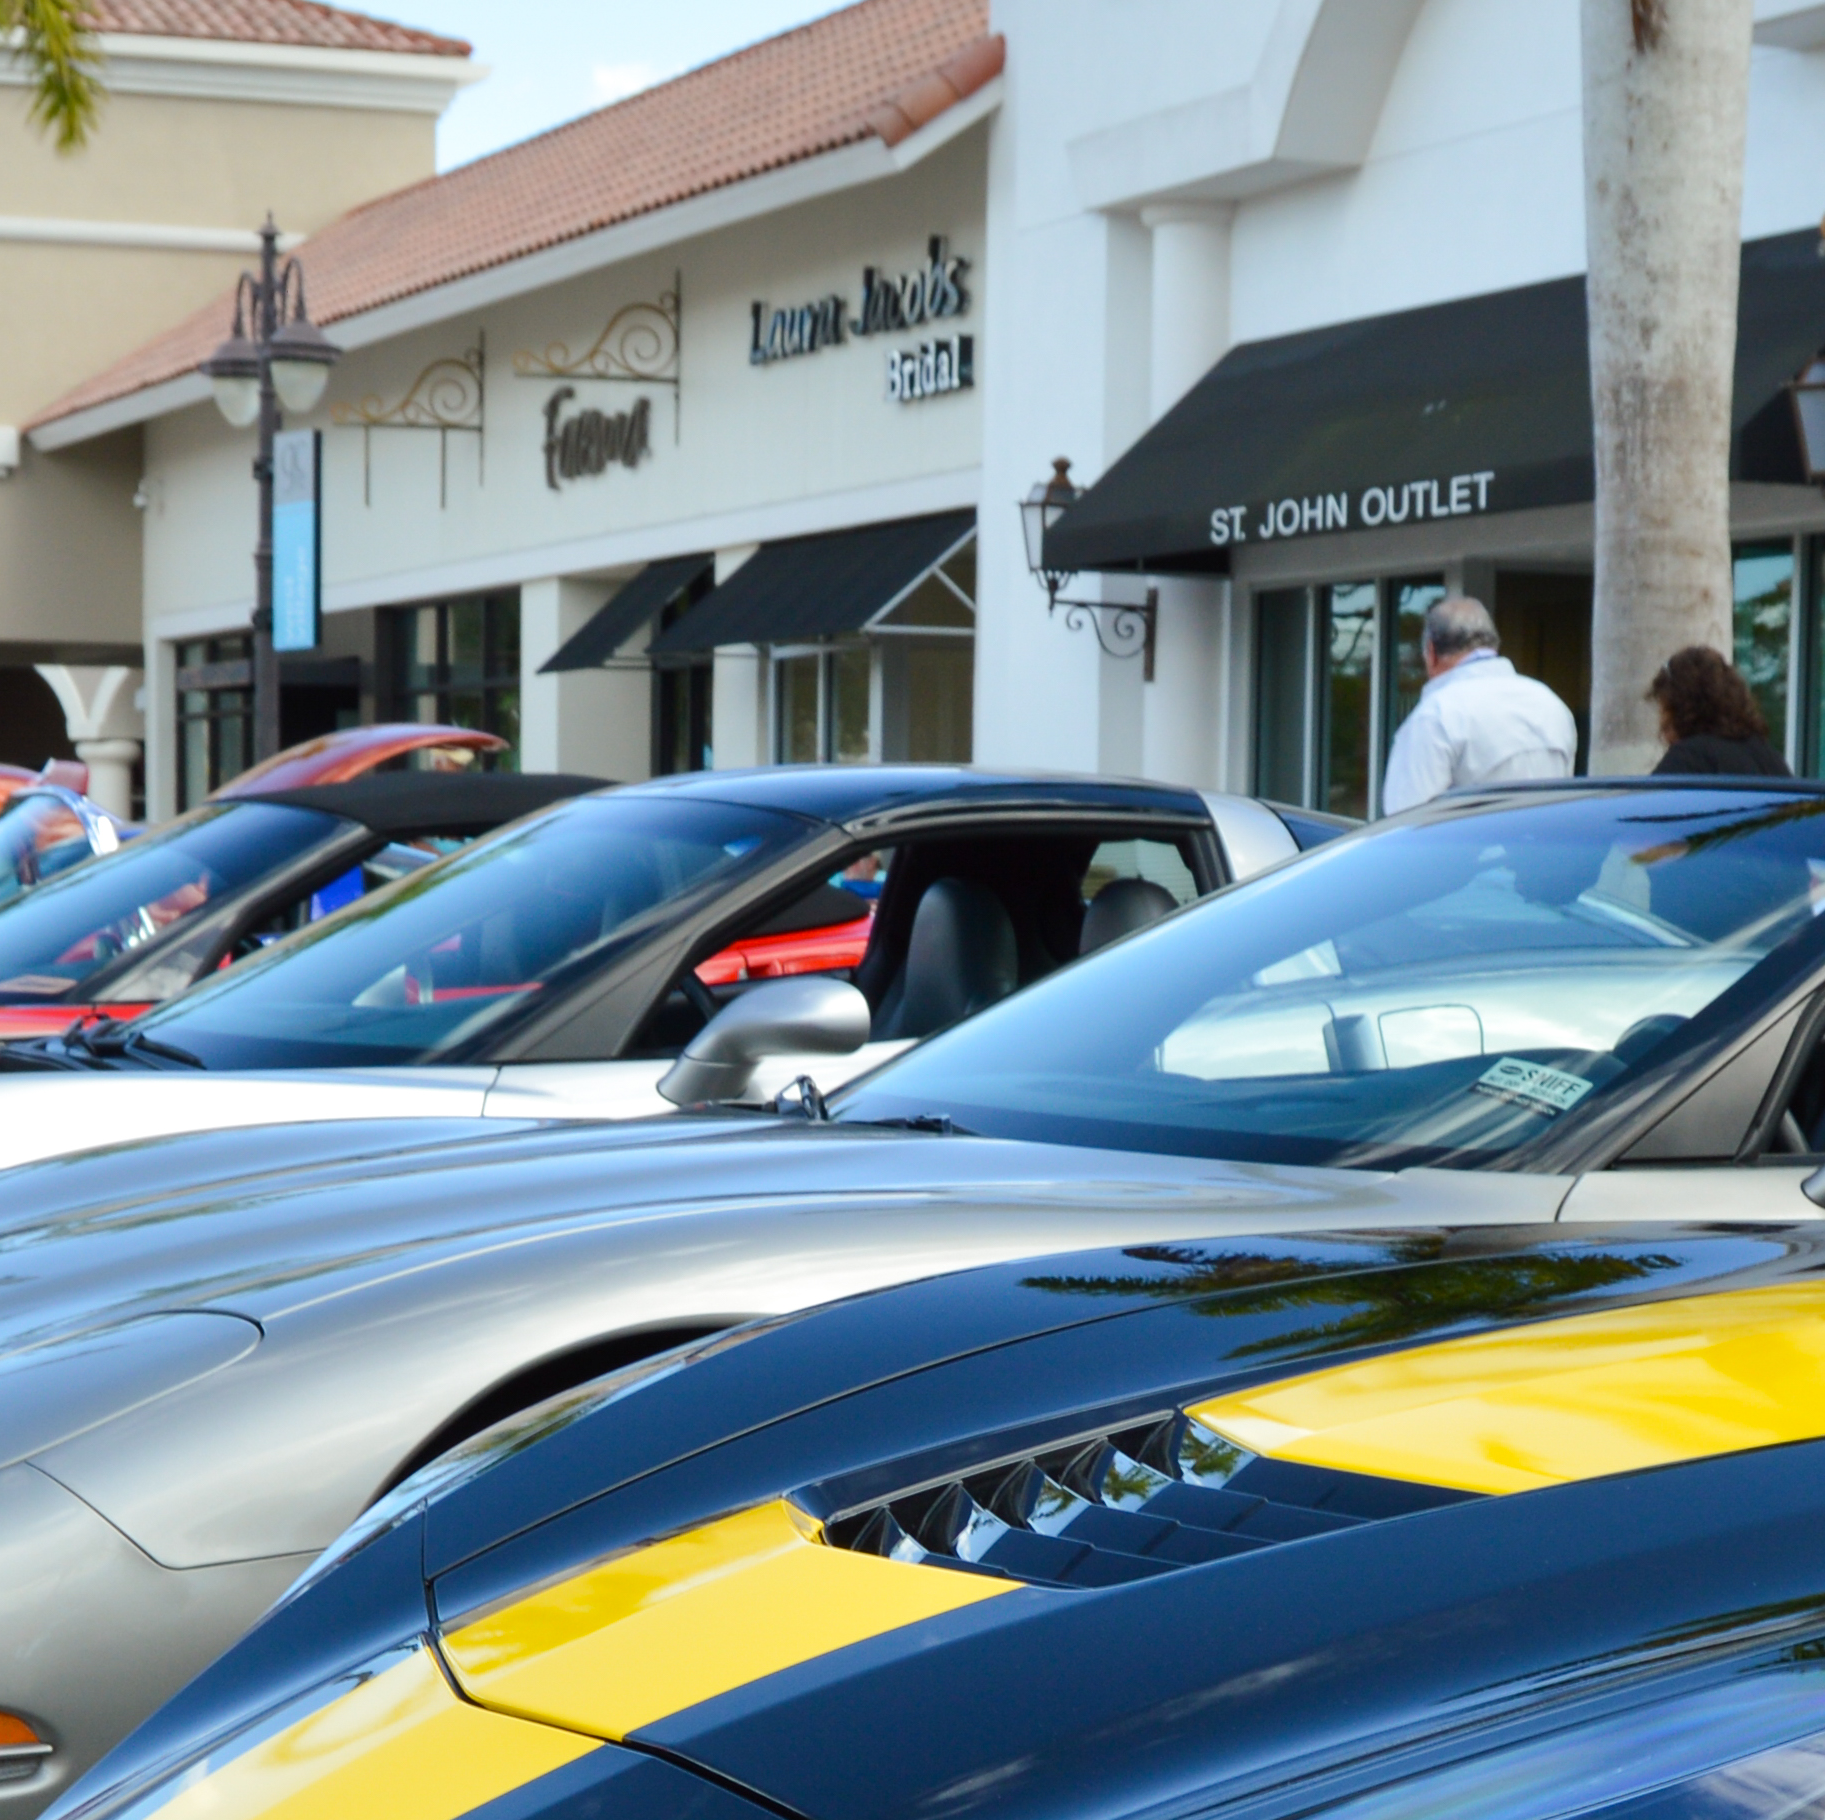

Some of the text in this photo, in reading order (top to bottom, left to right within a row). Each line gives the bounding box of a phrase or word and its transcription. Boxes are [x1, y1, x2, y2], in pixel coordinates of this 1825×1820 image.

[749, 235, 971, 366] Laura Jacobs
[886, 335, 973, 402] Bridal
[1210, 470, 1495, 545] ST. JOHN OUTLET
